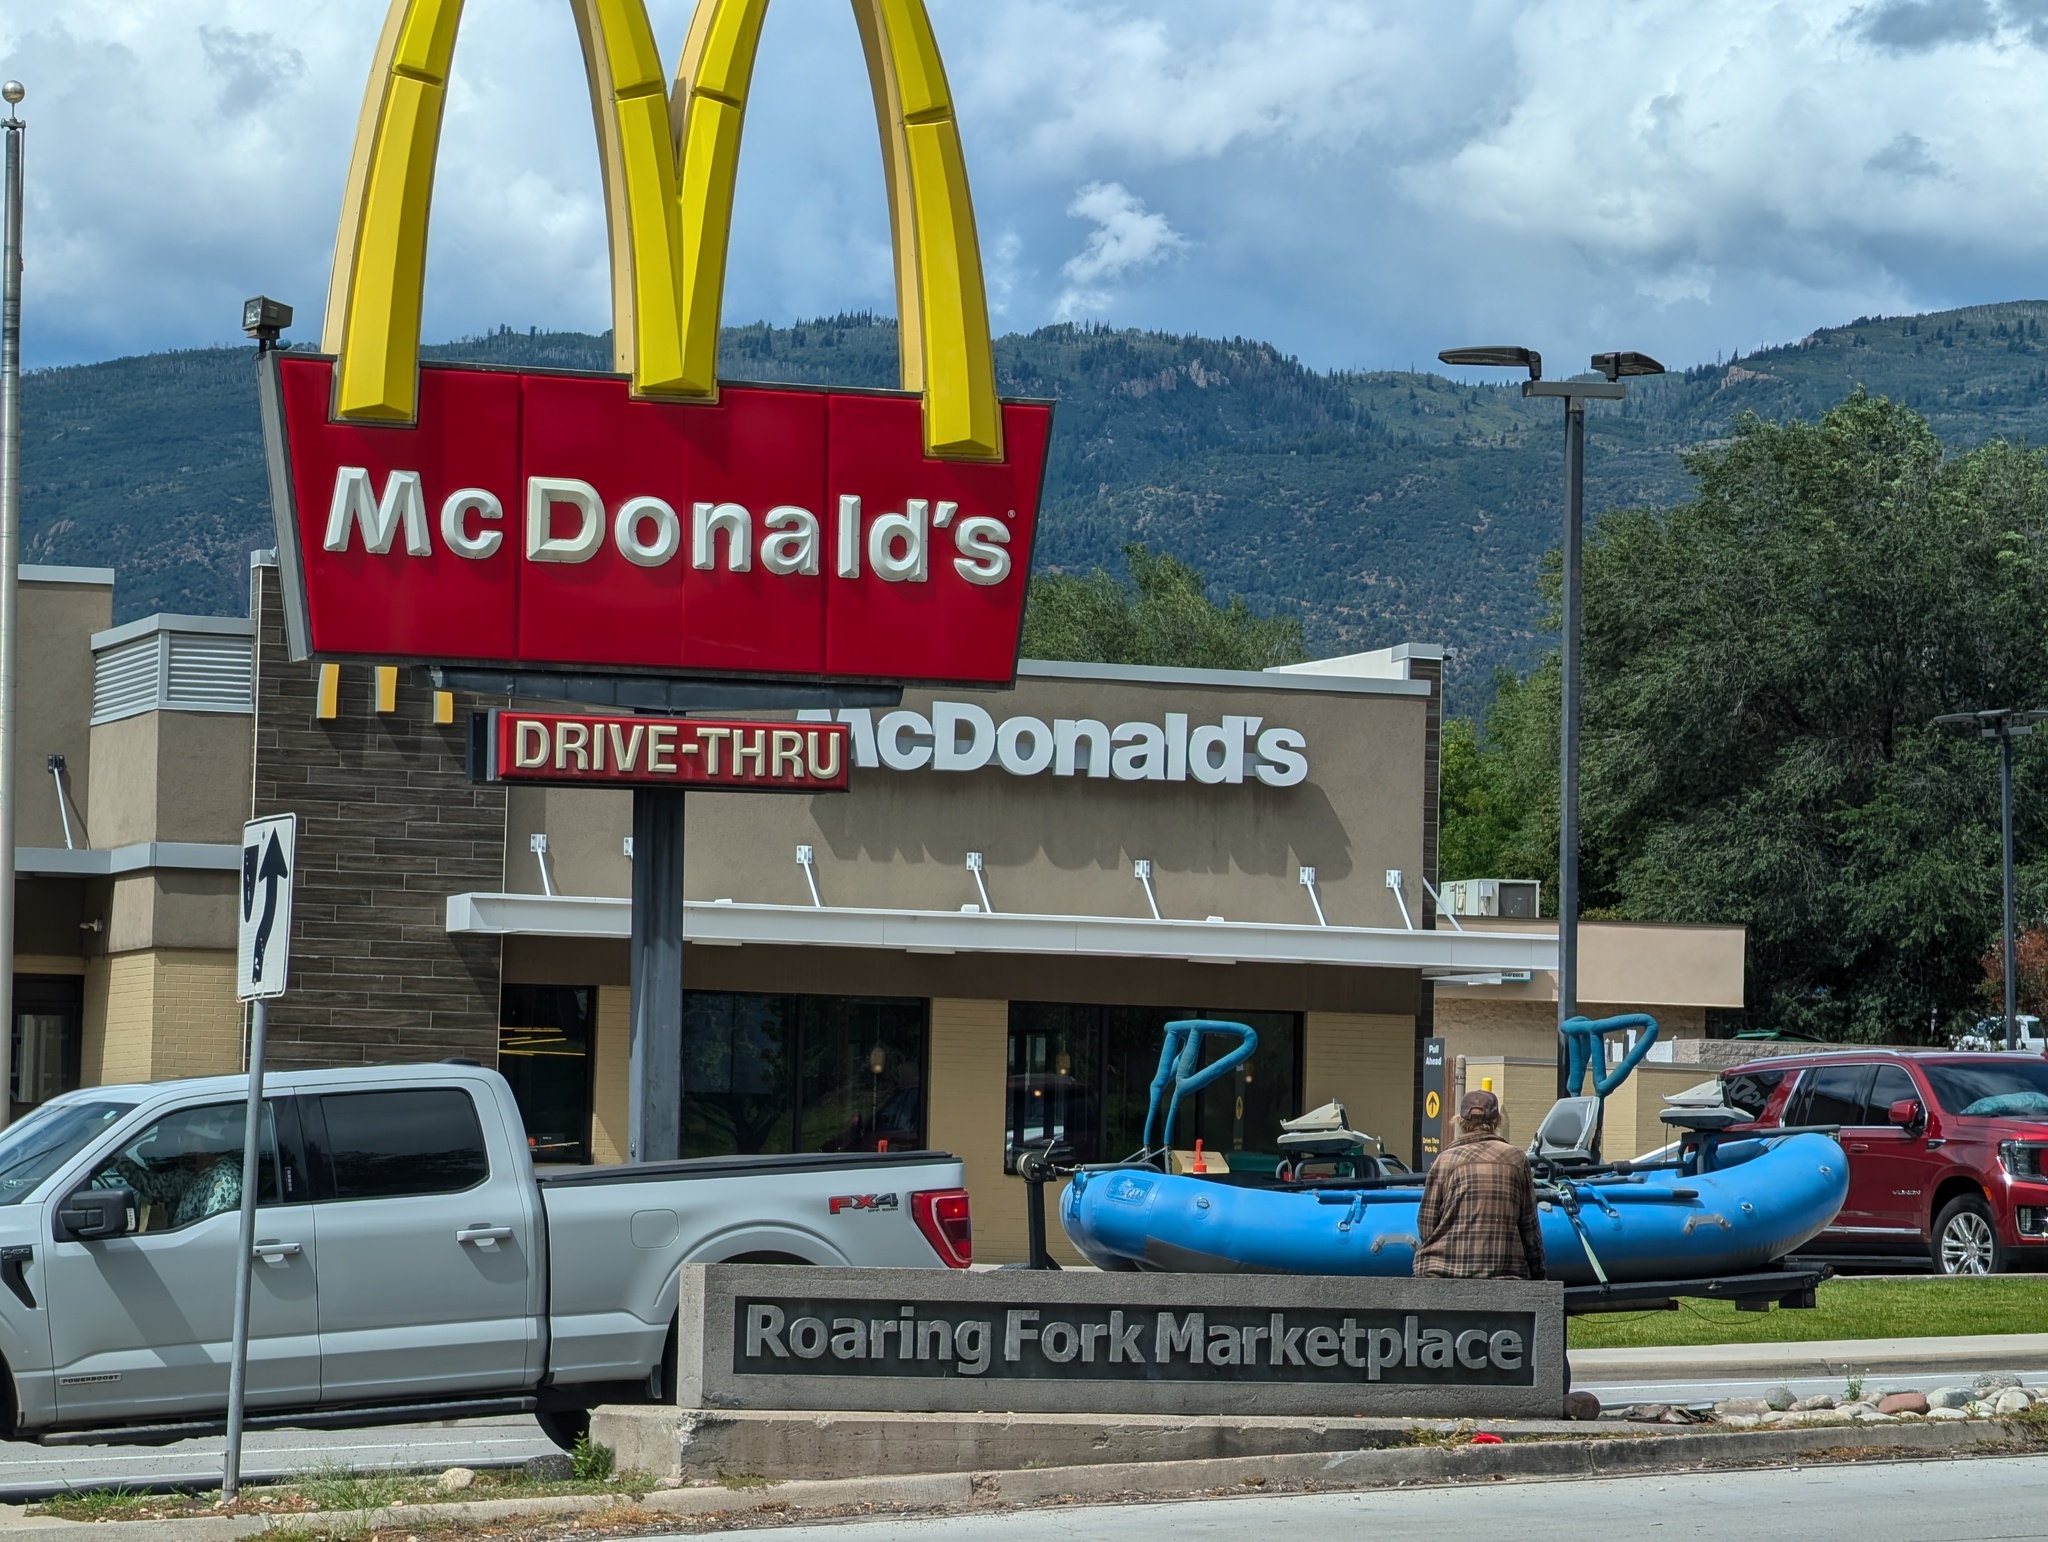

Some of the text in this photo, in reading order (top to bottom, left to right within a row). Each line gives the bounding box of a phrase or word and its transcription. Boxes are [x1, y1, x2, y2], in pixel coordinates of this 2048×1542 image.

[323, 466, 1012, 586] McDonald's
[515, 720, 841, 780] DRIVE-THRU
[1425, 1056, 1442, 1066] Ahead
[1428, 1044, 1440, 1054] Pull
[828, 1192, 899, 1214] FX4
[745, 1303, 1524, 1381] Roaring Fork Marketplace
